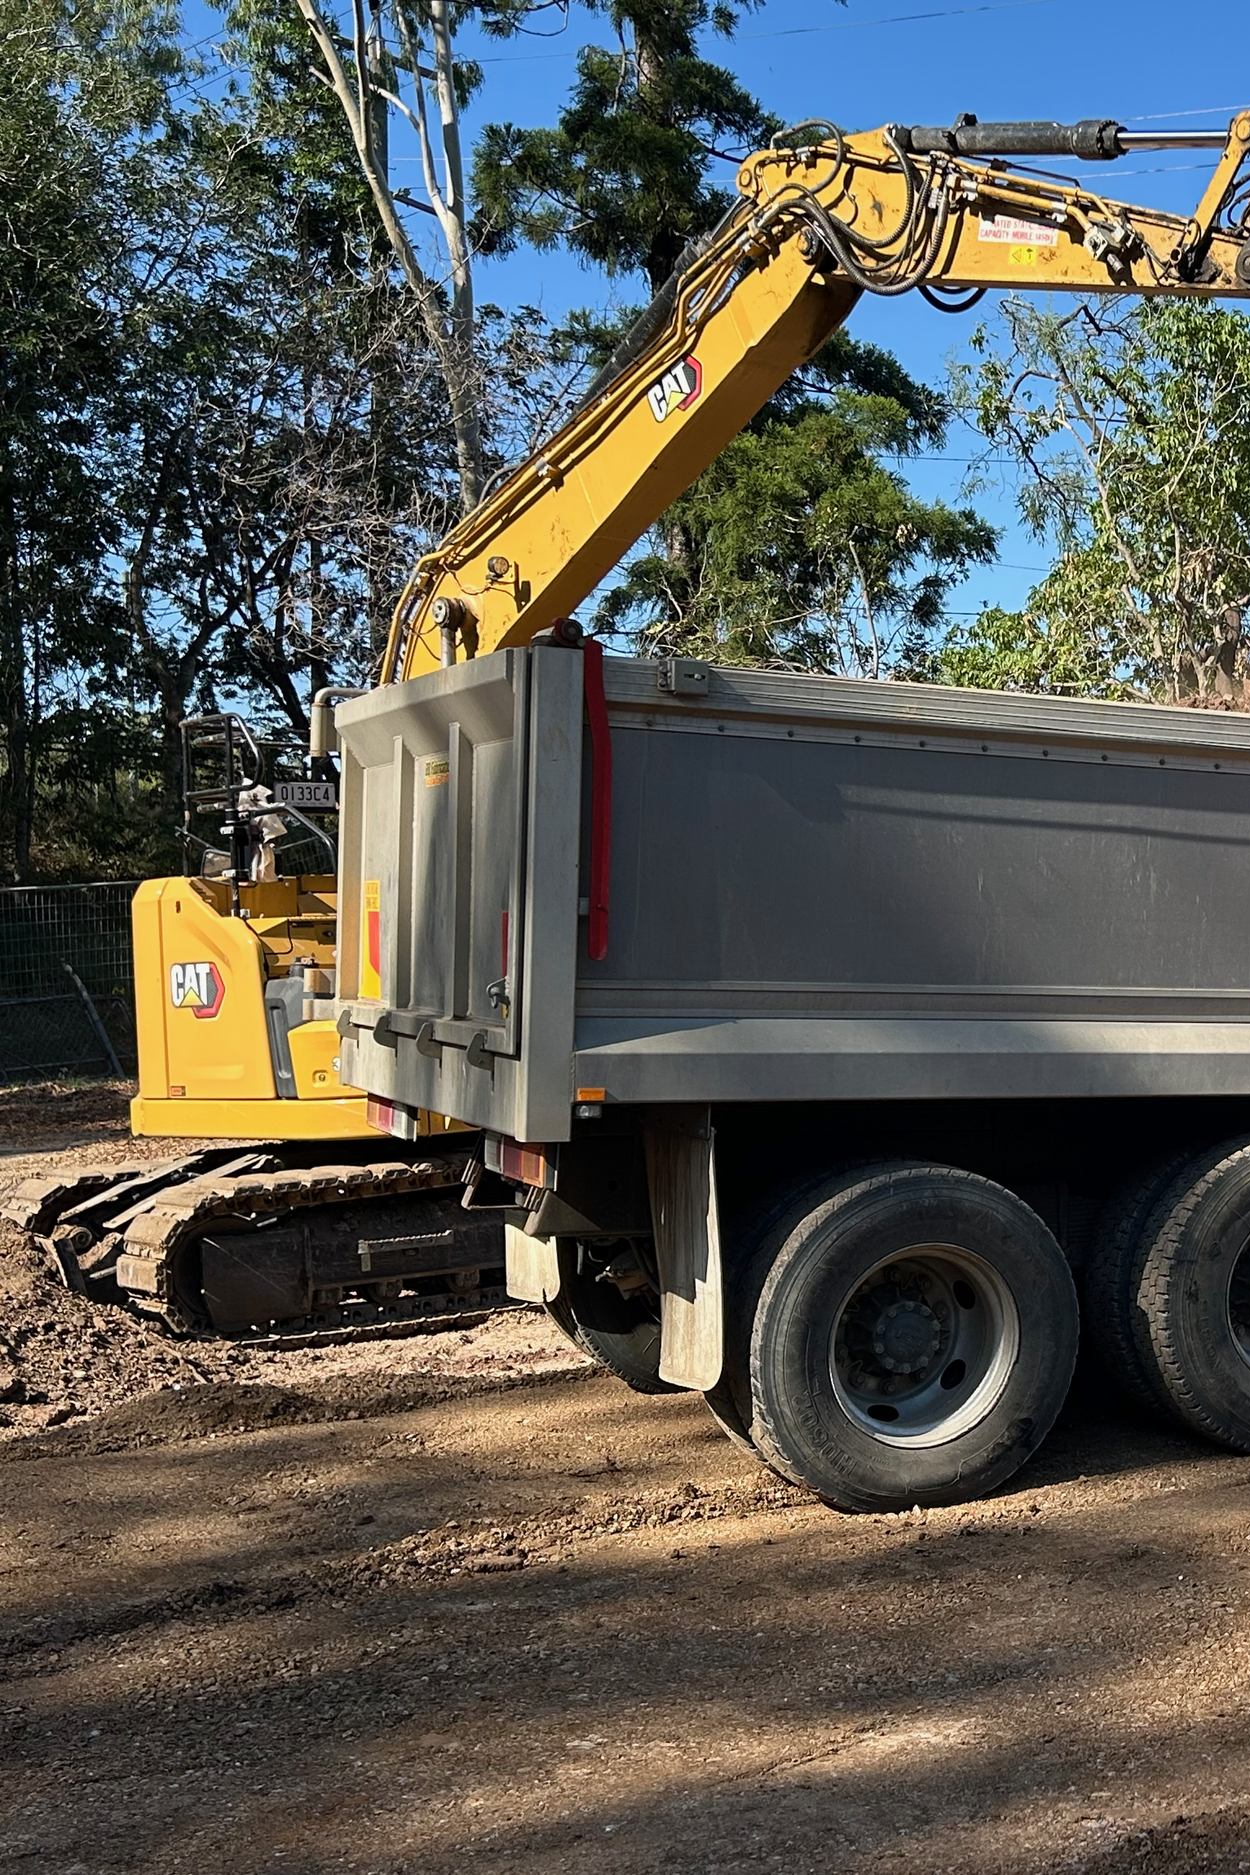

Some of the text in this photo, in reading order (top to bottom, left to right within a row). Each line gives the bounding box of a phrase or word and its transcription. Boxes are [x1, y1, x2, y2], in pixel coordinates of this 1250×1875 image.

[980, 229, 1010, 240] CAPACITY
[1012, 230, 1033, 241] MOBILE
[647, 360, 691, 422] CAT
[171, 963, 211, 1007] CAT
